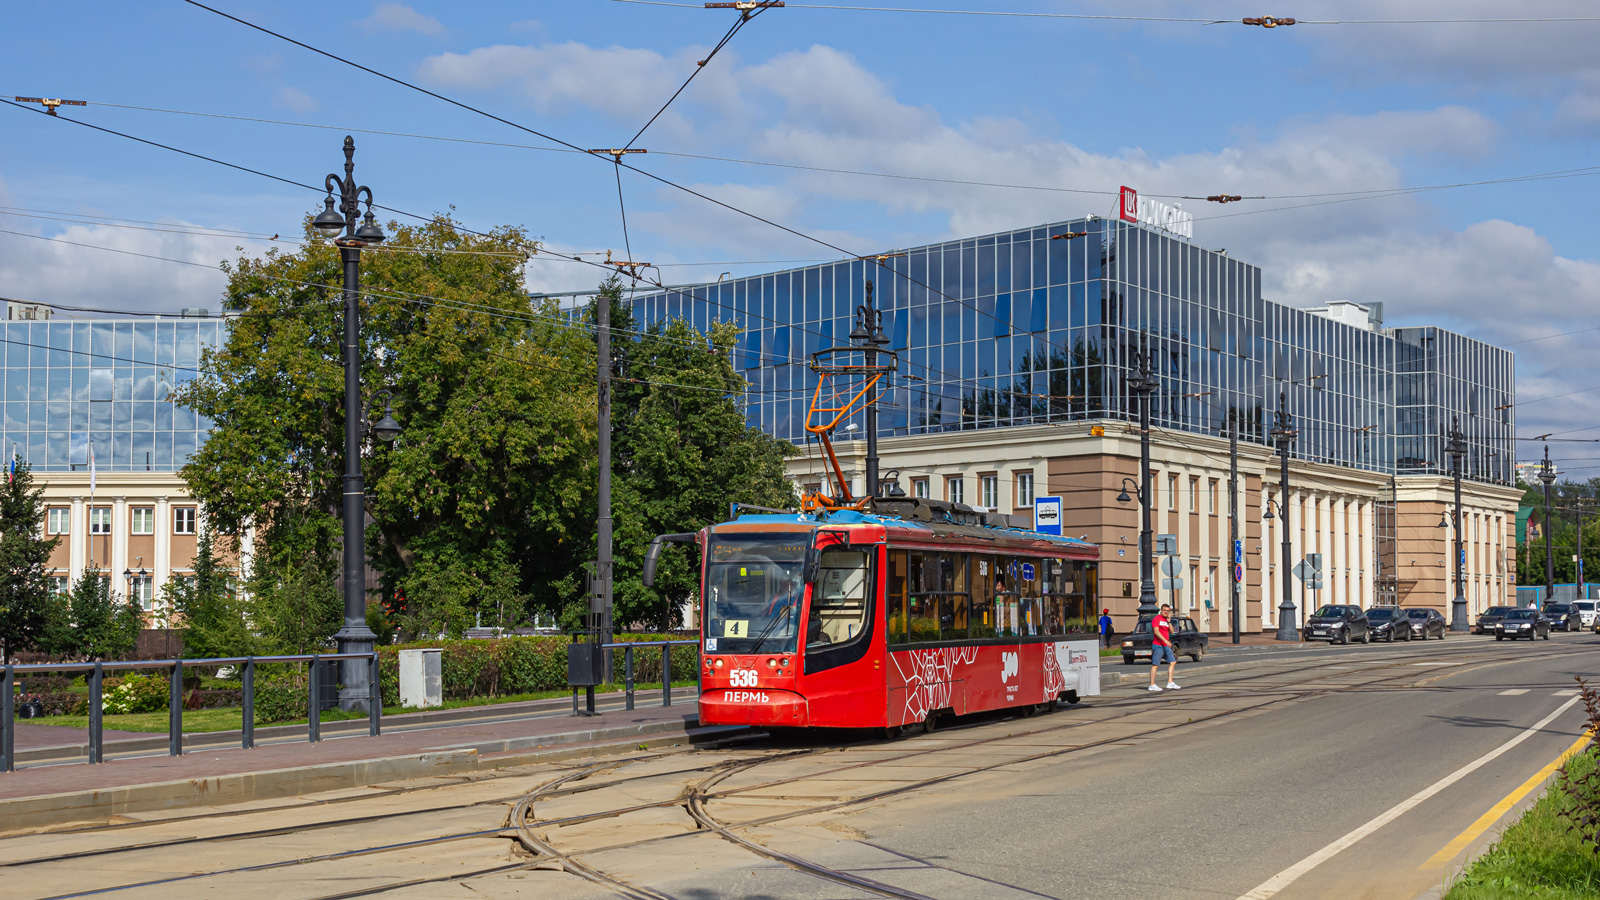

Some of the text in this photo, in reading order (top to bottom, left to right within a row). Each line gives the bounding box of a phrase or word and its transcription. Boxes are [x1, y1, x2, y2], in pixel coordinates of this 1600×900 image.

[729, 621, 740, 636] 4
[729, 669, 758, 687] 536
[724, 691, 770, 703] ПЕРМЬ
